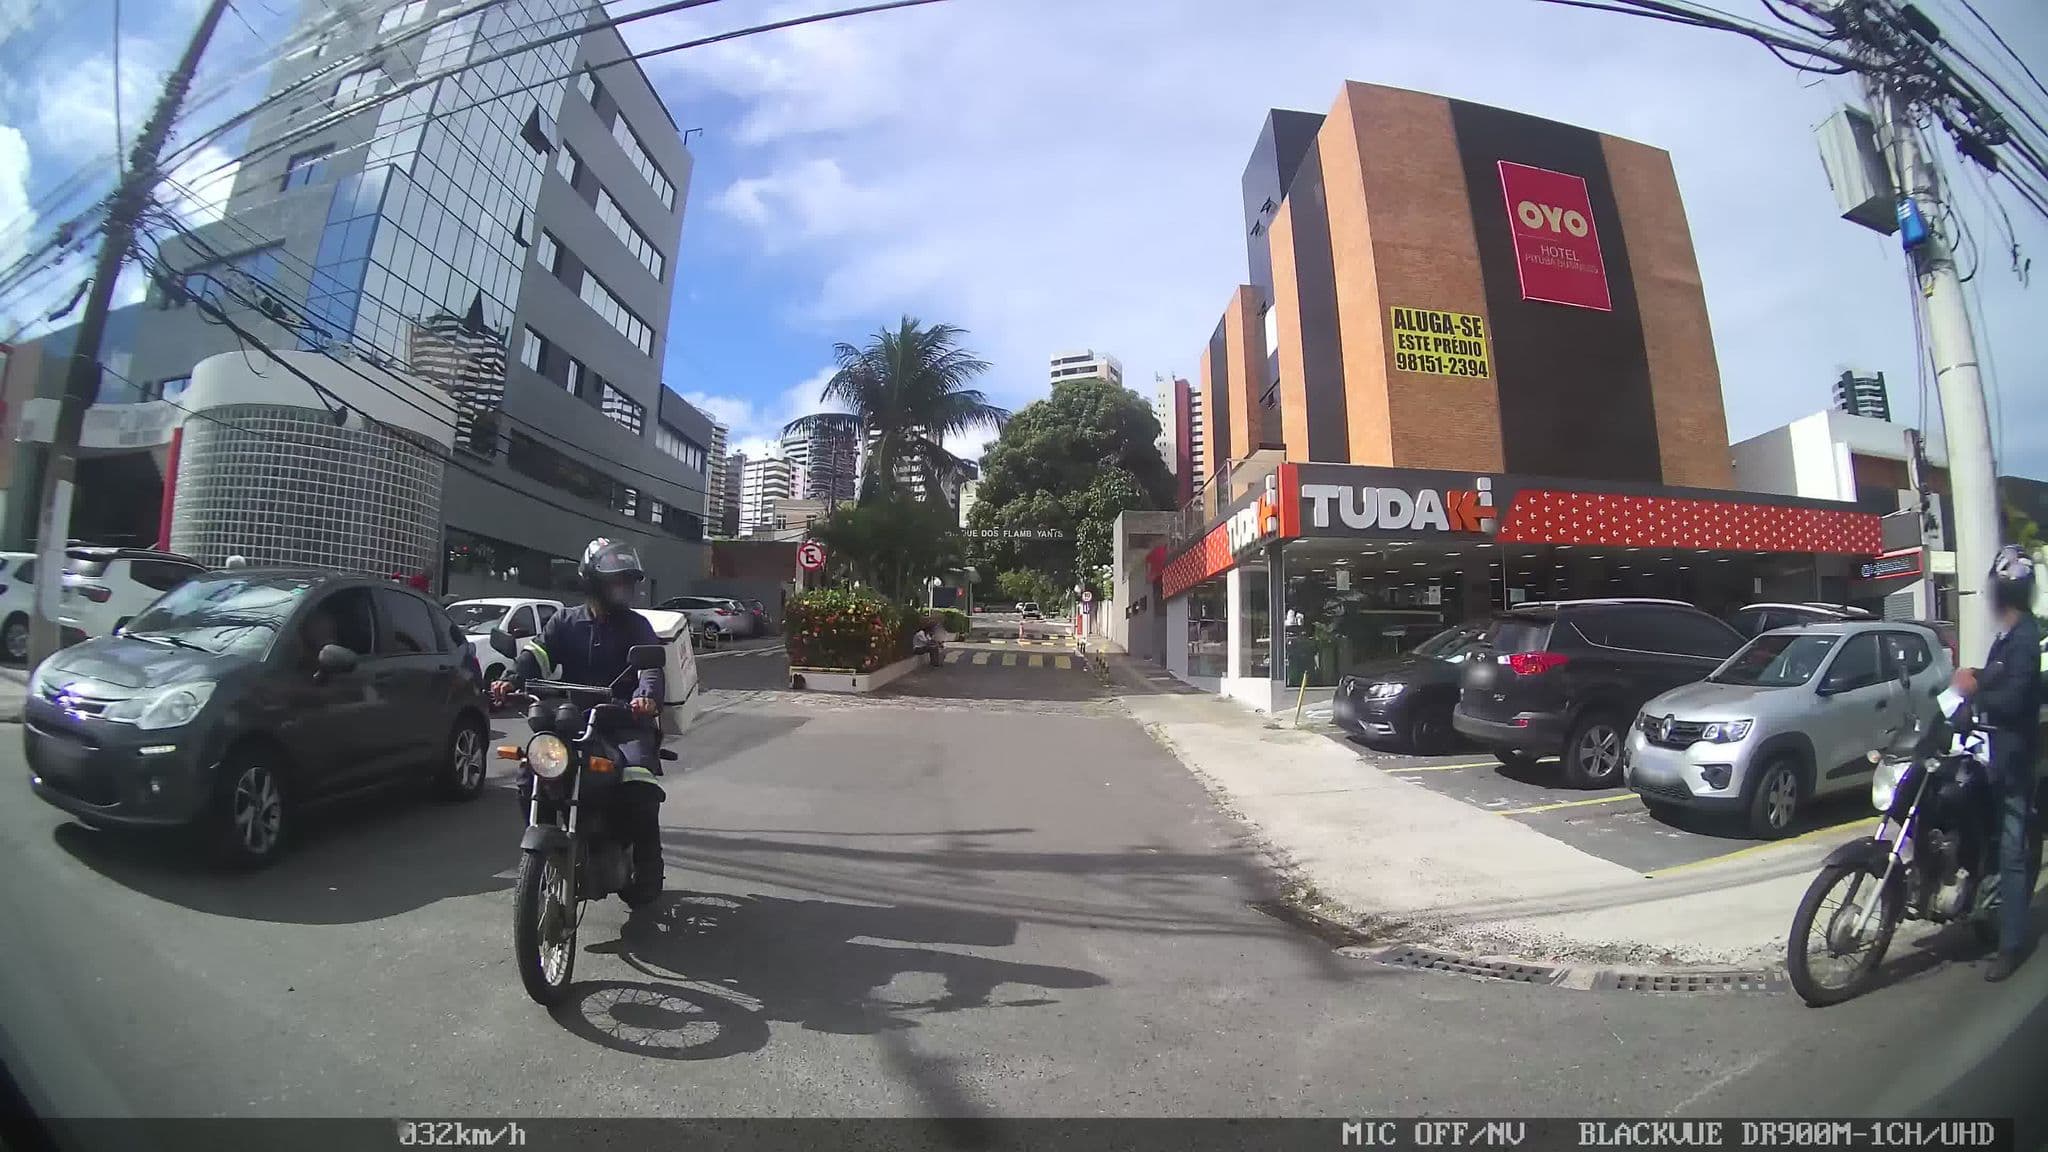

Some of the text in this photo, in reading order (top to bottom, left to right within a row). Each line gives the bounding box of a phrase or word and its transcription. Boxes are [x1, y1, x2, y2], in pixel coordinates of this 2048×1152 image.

[1517, 200, 1588, 238] OYO
[1540, 244, 1580, 262] HOTEL
[1394, 308, 1483, 338] ALUGA-SE
[1398, 333, 1482, 357] ESTE PRÉDIO
[1396, 352, 1488, 378] 98151-2394
[981, 529, 999, 538] DOS
[806, 549, 817, 564] E
